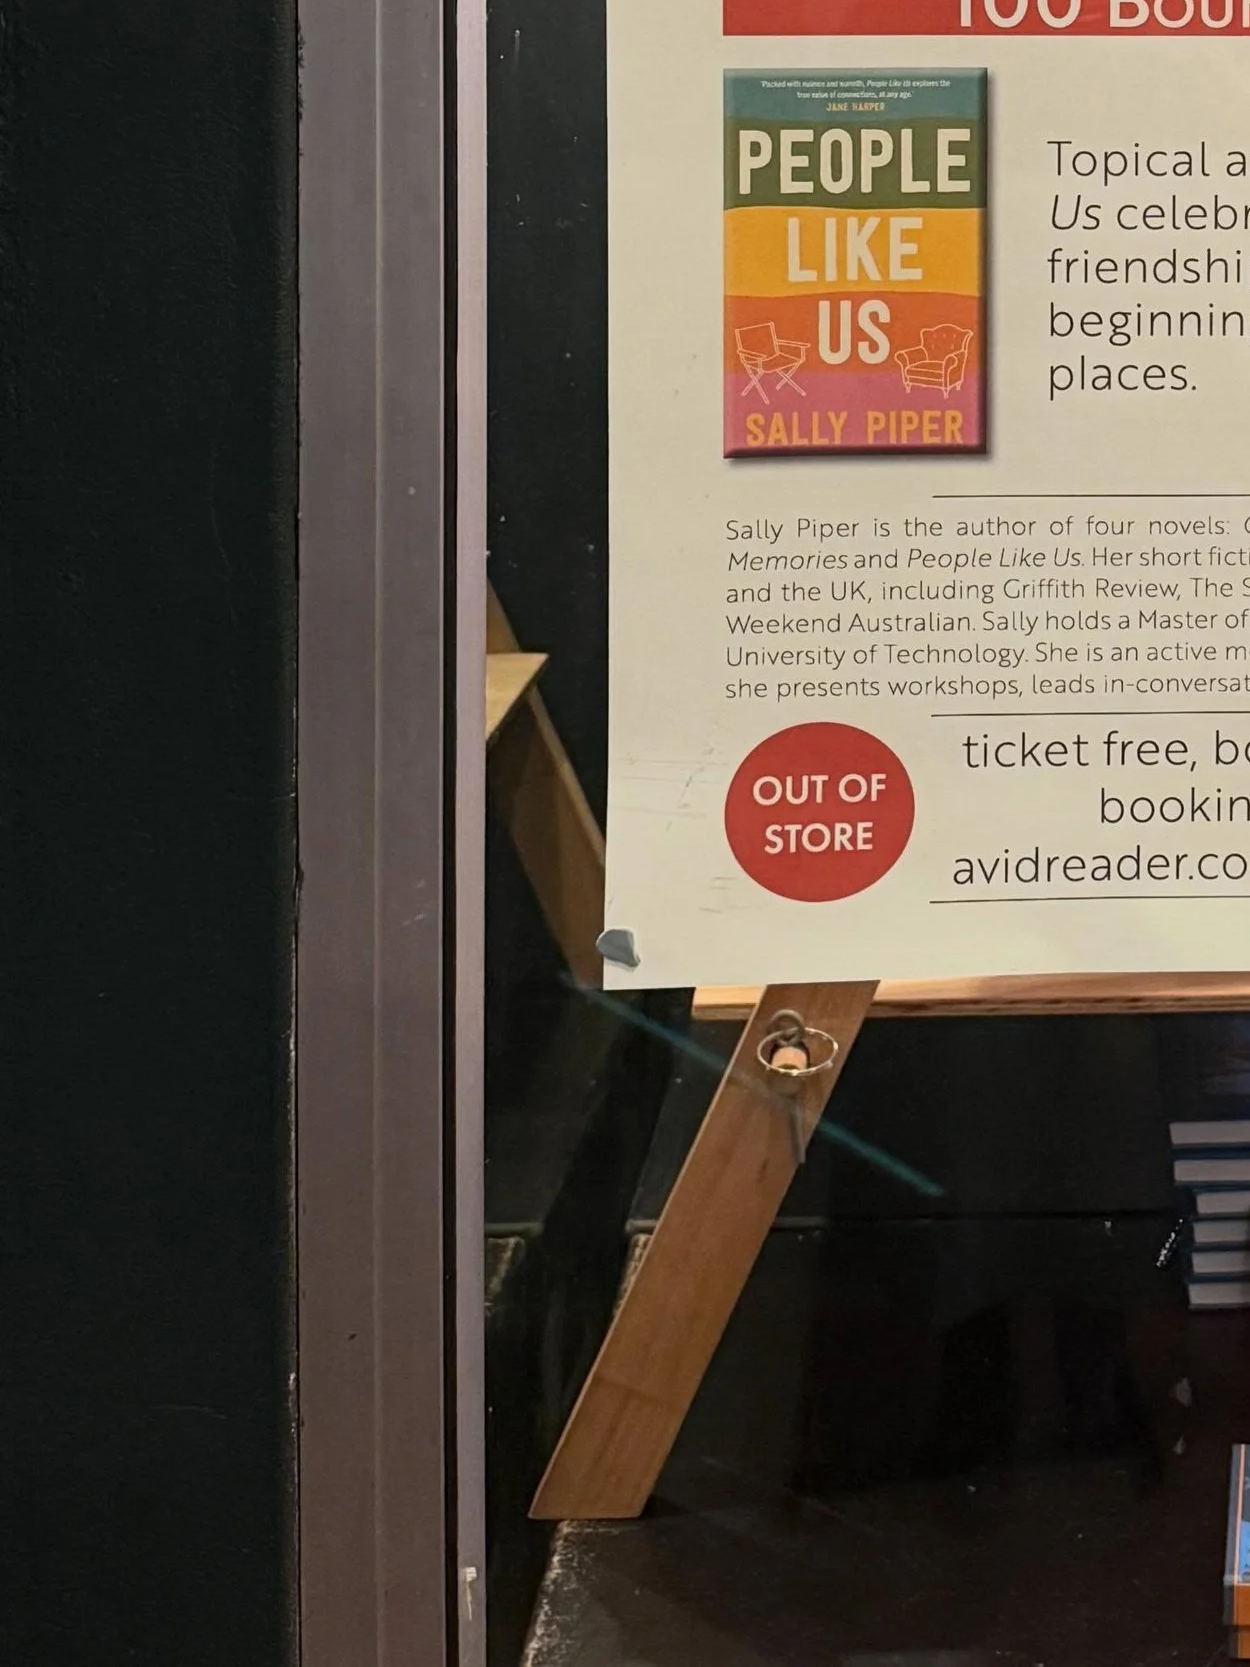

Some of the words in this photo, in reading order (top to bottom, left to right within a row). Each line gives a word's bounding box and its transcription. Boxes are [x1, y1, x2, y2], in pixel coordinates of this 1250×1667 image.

[740, 128, 971, 194] PEOPLE
[1046, 140, 1211, 187] Topical
[1051, 193, 1102, 231] Us
[788, 216, 923, 282] LIKE
[818, 299, 891, 365] US
[1049, 354, 1197, 402] places.
[745, 411, 848, 447] SALLY
[867, 409, 965, 445] PIPER
[726, 518, 784, 545] Sally
[797, 517, 860, 544] Piper
[873, 517, 891, 538] is
[903, 516, 944, 538] the
[956, 515, 1037, 537] author
[1049, 514, 1075, 536] of
[1085, 514, 1136, 536] four
[1149, 514, 1229, 536] novels:
[727, 550, 849, 572] Memories
[853, 547, 899, 570] and
[907, 547, 993, 574] People
[999, 546, 1047, 568] Like
[1053, 546, 1085, 568] Us.
[1092, 546, 1134, 567] Her
[1139, 546, 1203, 567] short
[726, 645, 846, 671] University
[852, 643, 879, 665] of
[883, 642, 1029, 669] Technology.
[1034, 641, 1079, 663] She
[1086, 642, 1104, 663] is
[1110, 646, 1139, 662] an
[1146, 641, 1217, 662] active
[724, 677, 768, 699] she
[777, 677, 881, 703] presents
[887, 674, 1023, 701] workshops,
[1032, 672, 1095, 695] leads
[961, 731, 1090, 769] ticket
[1102, 729, 1197, 773] free,
[755, 774, 829, 806] OUT
[838, 773, 886, 803] OF
[764, 821, 873, 854] STORE
